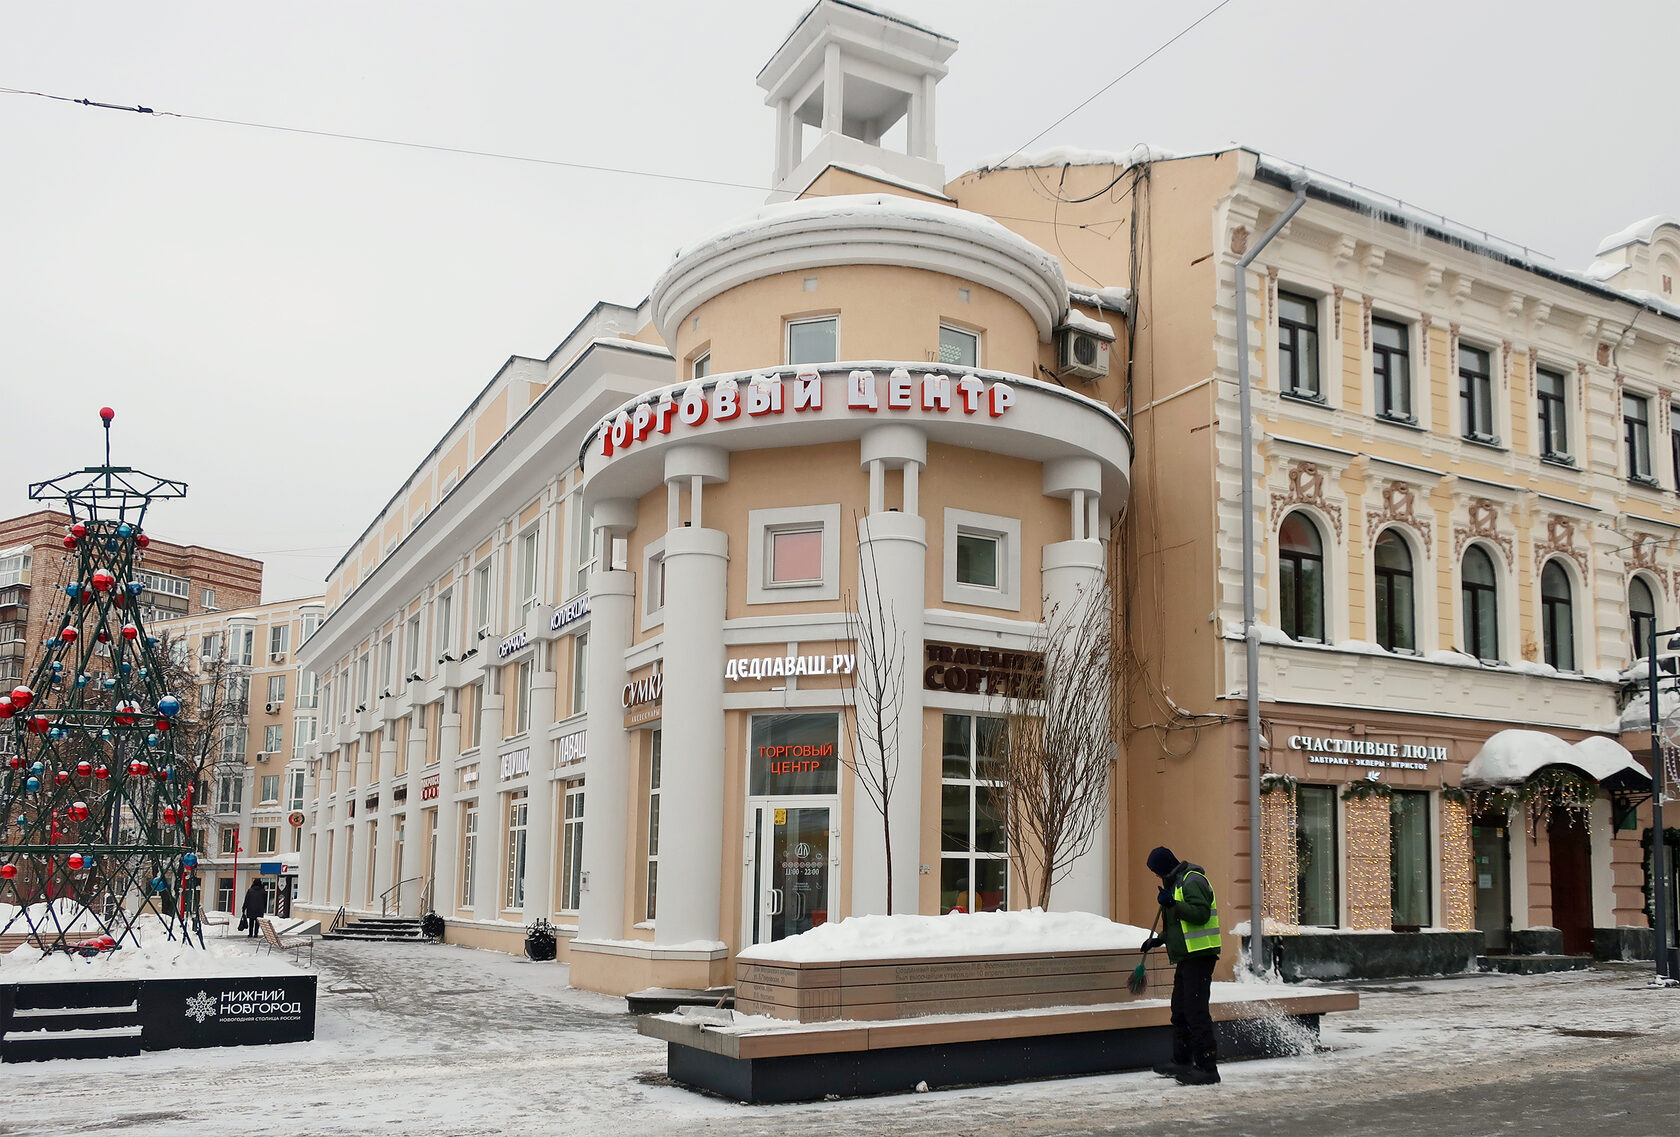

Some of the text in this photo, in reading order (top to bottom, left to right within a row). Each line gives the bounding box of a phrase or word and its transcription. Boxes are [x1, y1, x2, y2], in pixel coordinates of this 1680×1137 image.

[598, 370, 1017, 456] ТОРГОВЫЙ ЦЕНТР
[724, 654, 856, 682] ДЕДЛАВАШ.РУ
[622, 672, 664, 708] СУМКИ
[559, 731, 587, 763] ЛАВАШ
[757, 742, 833, 758] ТОРГОВЫЙ
[1288, 735, 1448, 762] СЧАСТЛИВЫЕ ЛЮДИ
[771, 761, 821, 775] ЦЕНТР
[1309, 756, 1428, 770] ЗАВТРАКИ ЭКЛЕРЫ ИГРИСТОЕ
[221, 989, 285, 1002] НИЖНИЙ
[220, 1002, 301, 1015] НОВГОРОД
